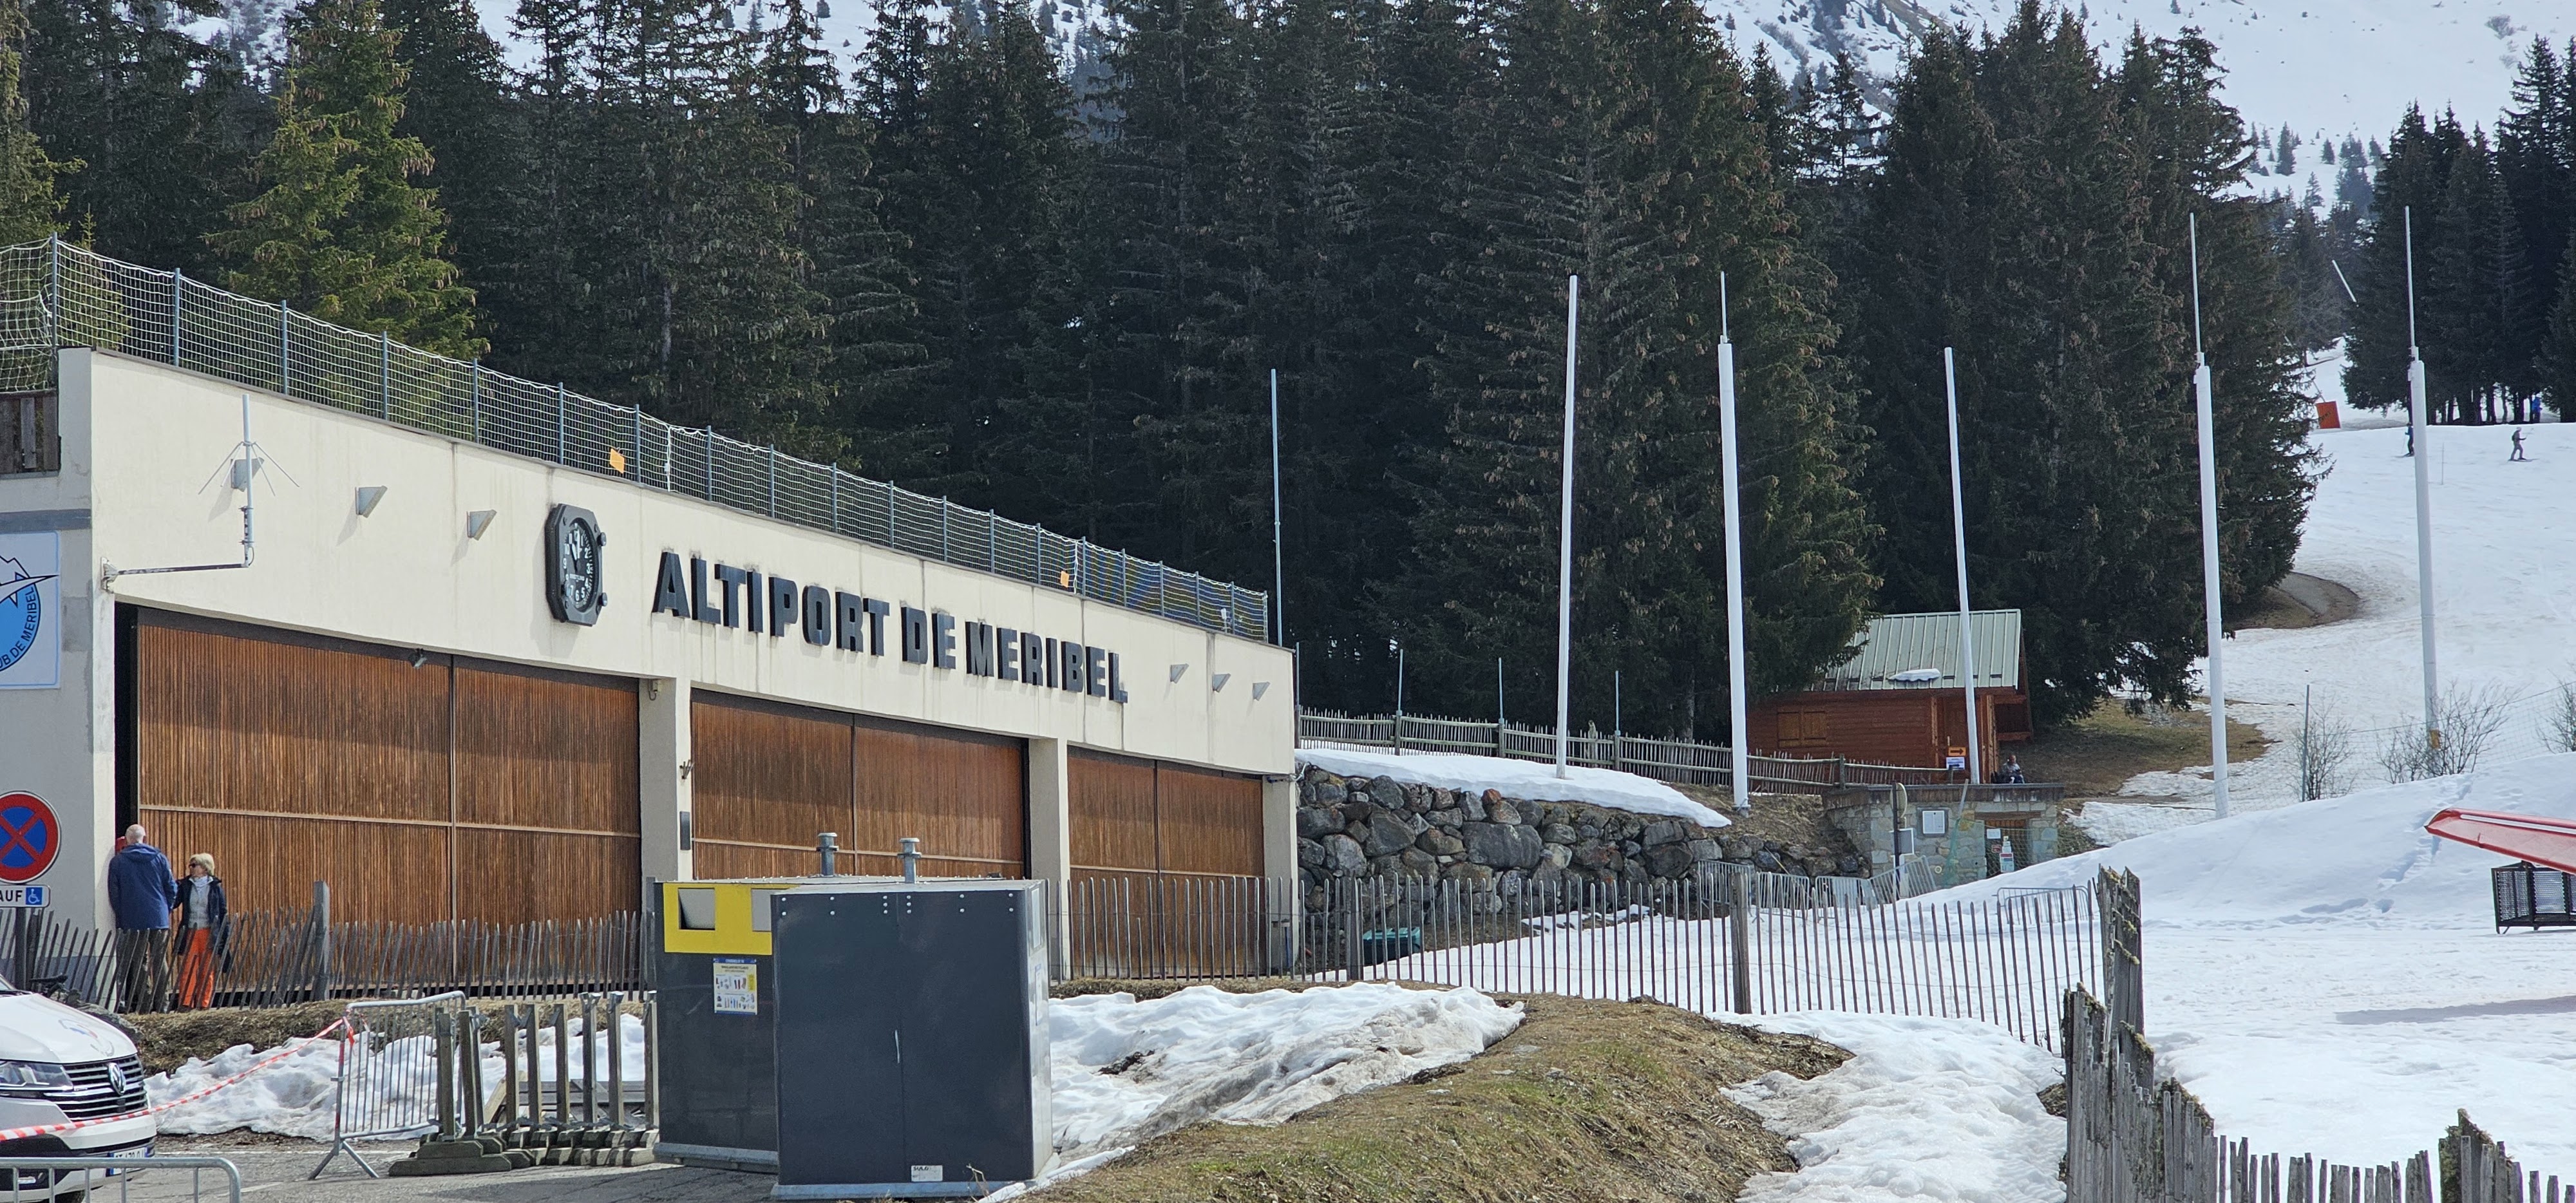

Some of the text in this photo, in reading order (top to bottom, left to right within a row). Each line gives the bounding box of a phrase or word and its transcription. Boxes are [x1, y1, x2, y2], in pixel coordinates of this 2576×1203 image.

[584, 547, 589, 559] 2
[563, 558, 567, 569] 9
[586, 563, 591, 574] 3
[585, 578, 589, 589] 4
[570, 585, 574, 596] 7
[575, 589, 580, 601] 6
[581, 587, 585, 598] 5
[10, 640, 26, 658] DE
[21, 587, 37, 641] MERIBEL
[651, 551, 1128, 703] ALTIPORT DE MERIBEL
